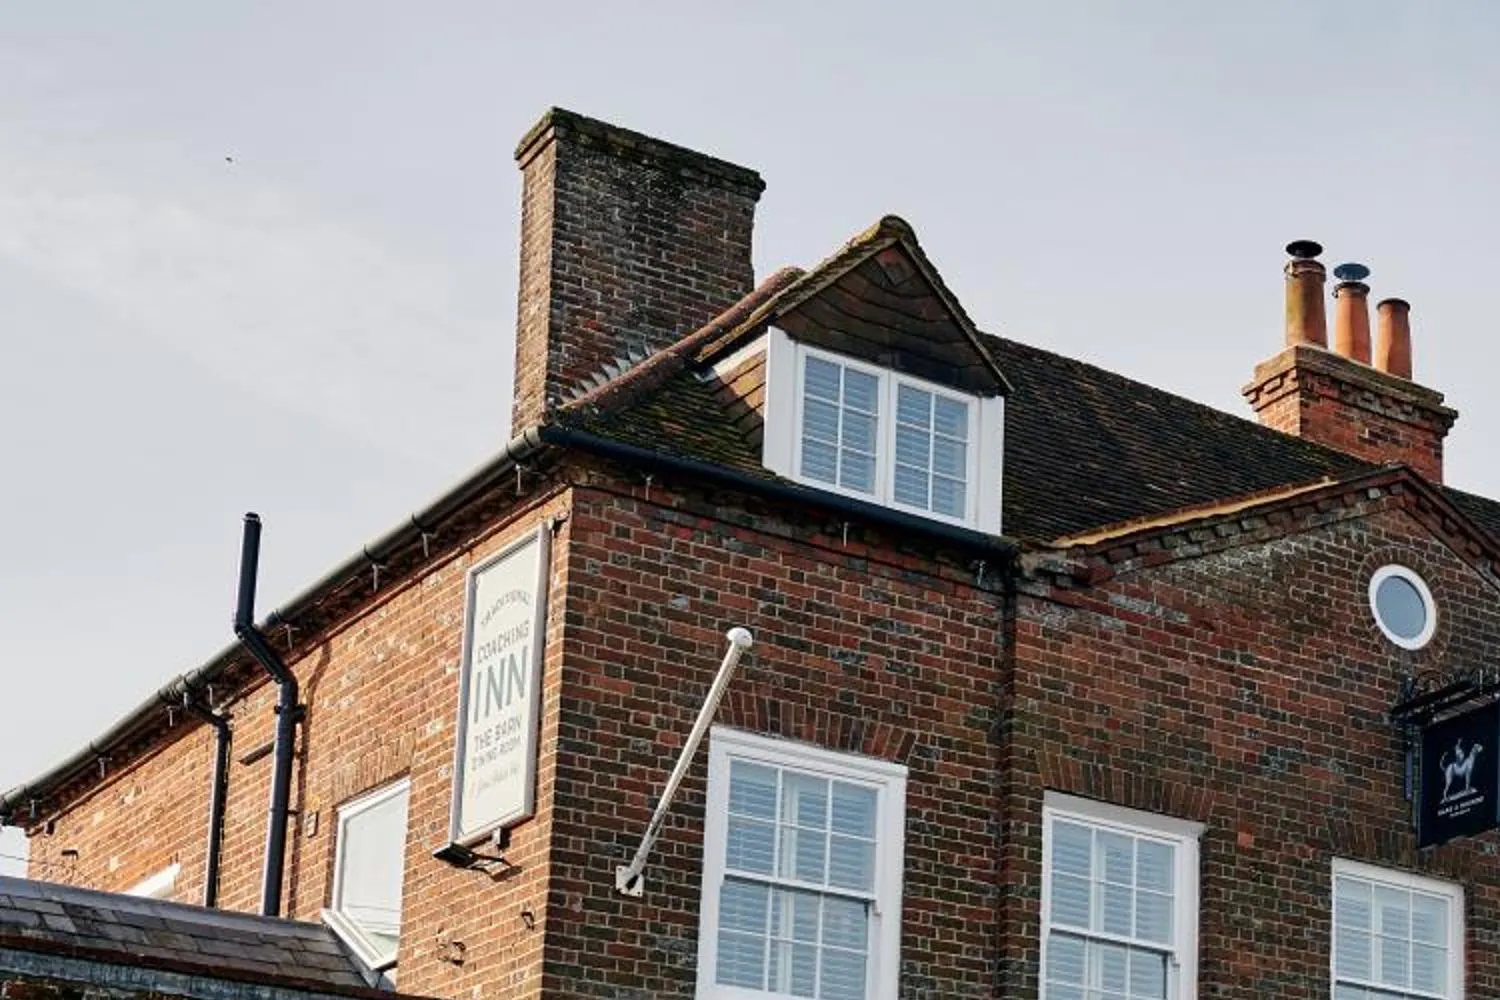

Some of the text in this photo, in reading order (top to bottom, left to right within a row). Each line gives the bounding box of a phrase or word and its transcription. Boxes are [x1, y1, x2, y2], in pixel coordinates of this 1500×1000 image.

[477, 620, 529, 663] COACHING
[474, 645, 528, 724] INN
[474, 727, 492, 752] THE
